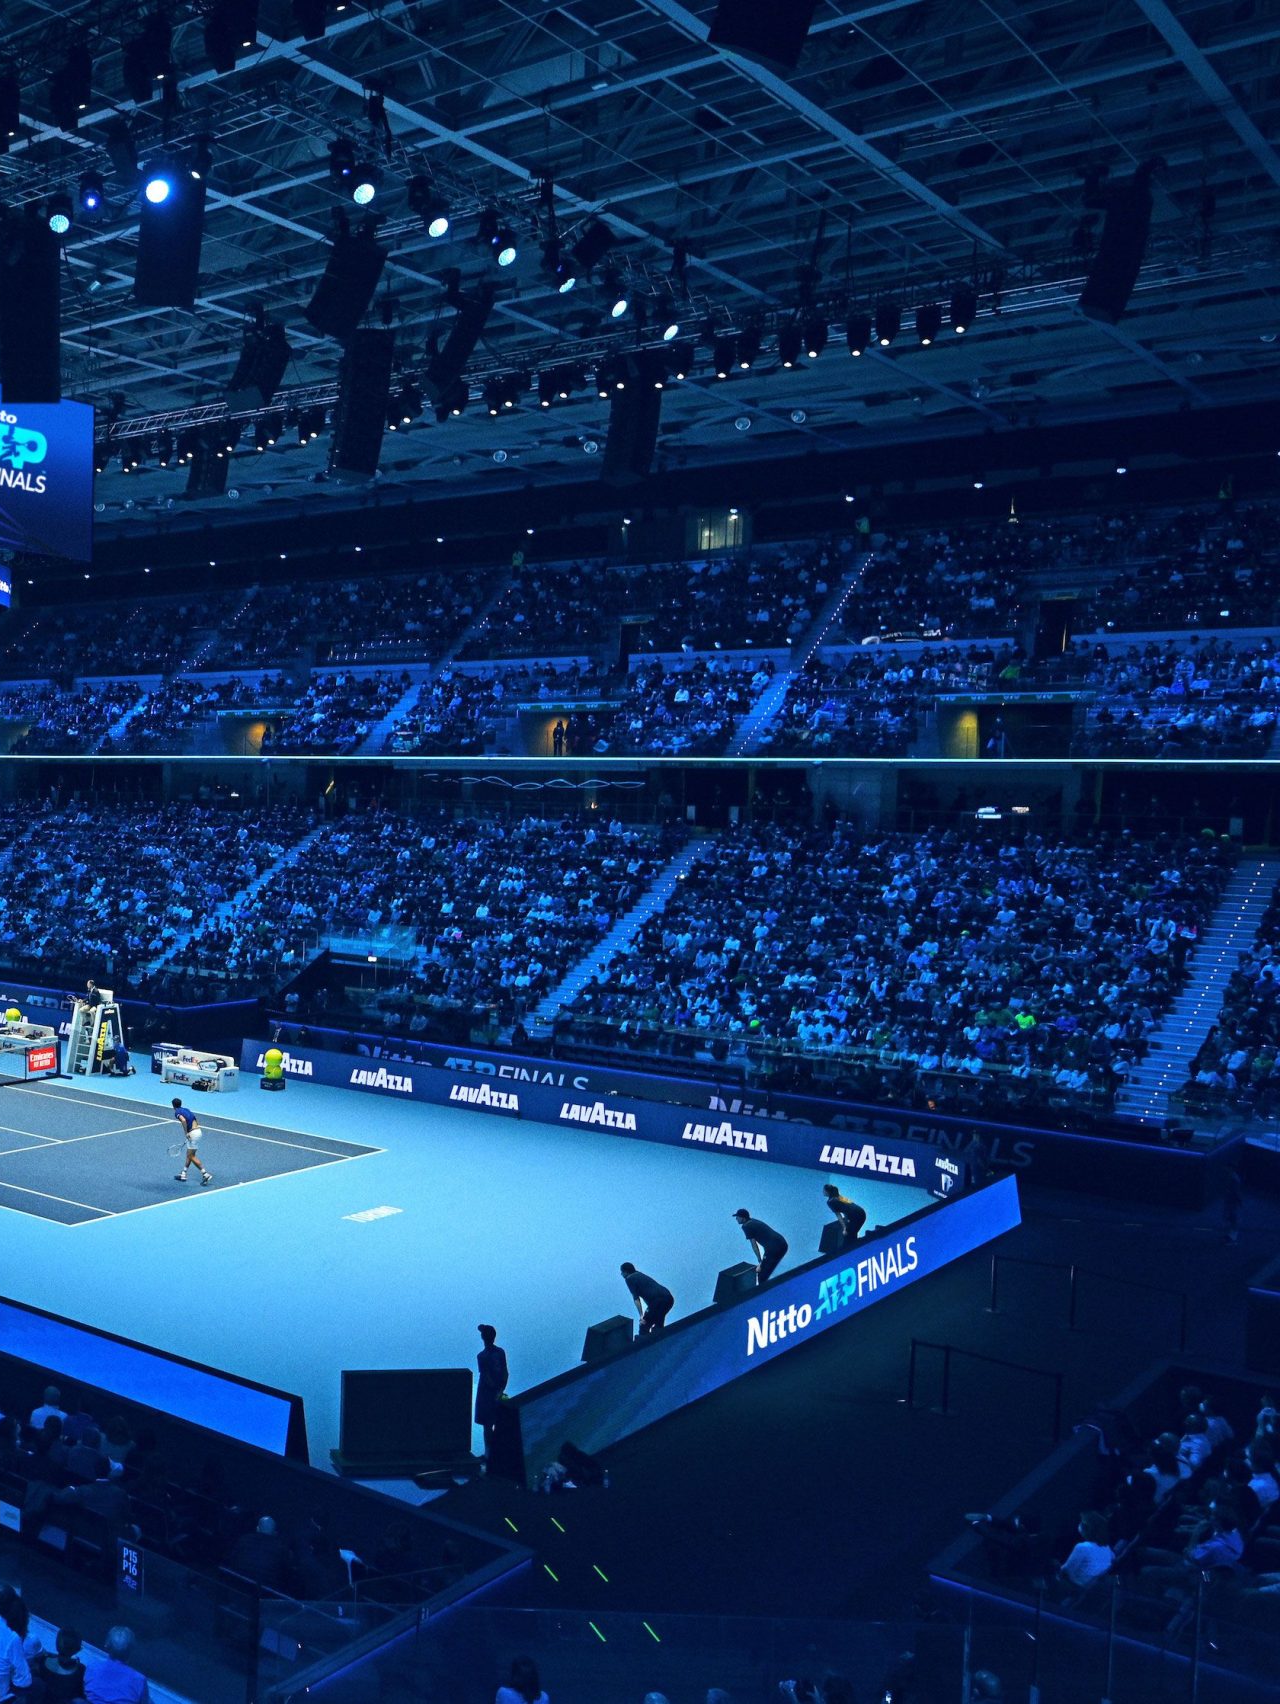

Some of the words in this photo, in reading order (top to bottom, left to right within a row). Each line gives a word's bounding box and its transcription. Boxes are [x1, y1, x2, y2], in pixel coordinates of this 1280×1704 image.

[182, 1055, 199, 1064] FedEx
[256, 1052, 313, 1076] LAZZA
[173, 1073, 190, 1082] FedEx
[349, 1067, 413, 1093] LAVAZZA
[450, 1083, 519, 1111] LAVAZZA
[559, 1102, 637, 1131] LAVAZZA
[682, 1121, 768, 1152] LAVAZZA
[819, 1144, 916, 1178] LAVAZZA
[935, 1157, 959, 1175] LAVAZZA
[747, 1303, 812, 1356] Nitto
[813, 1267, 857, 1321] ATP
[857, 1236, 918, 1297] FINALS
[122, 1559, 138, 1576] P16
[123, 1546, 138, 1564] P15
